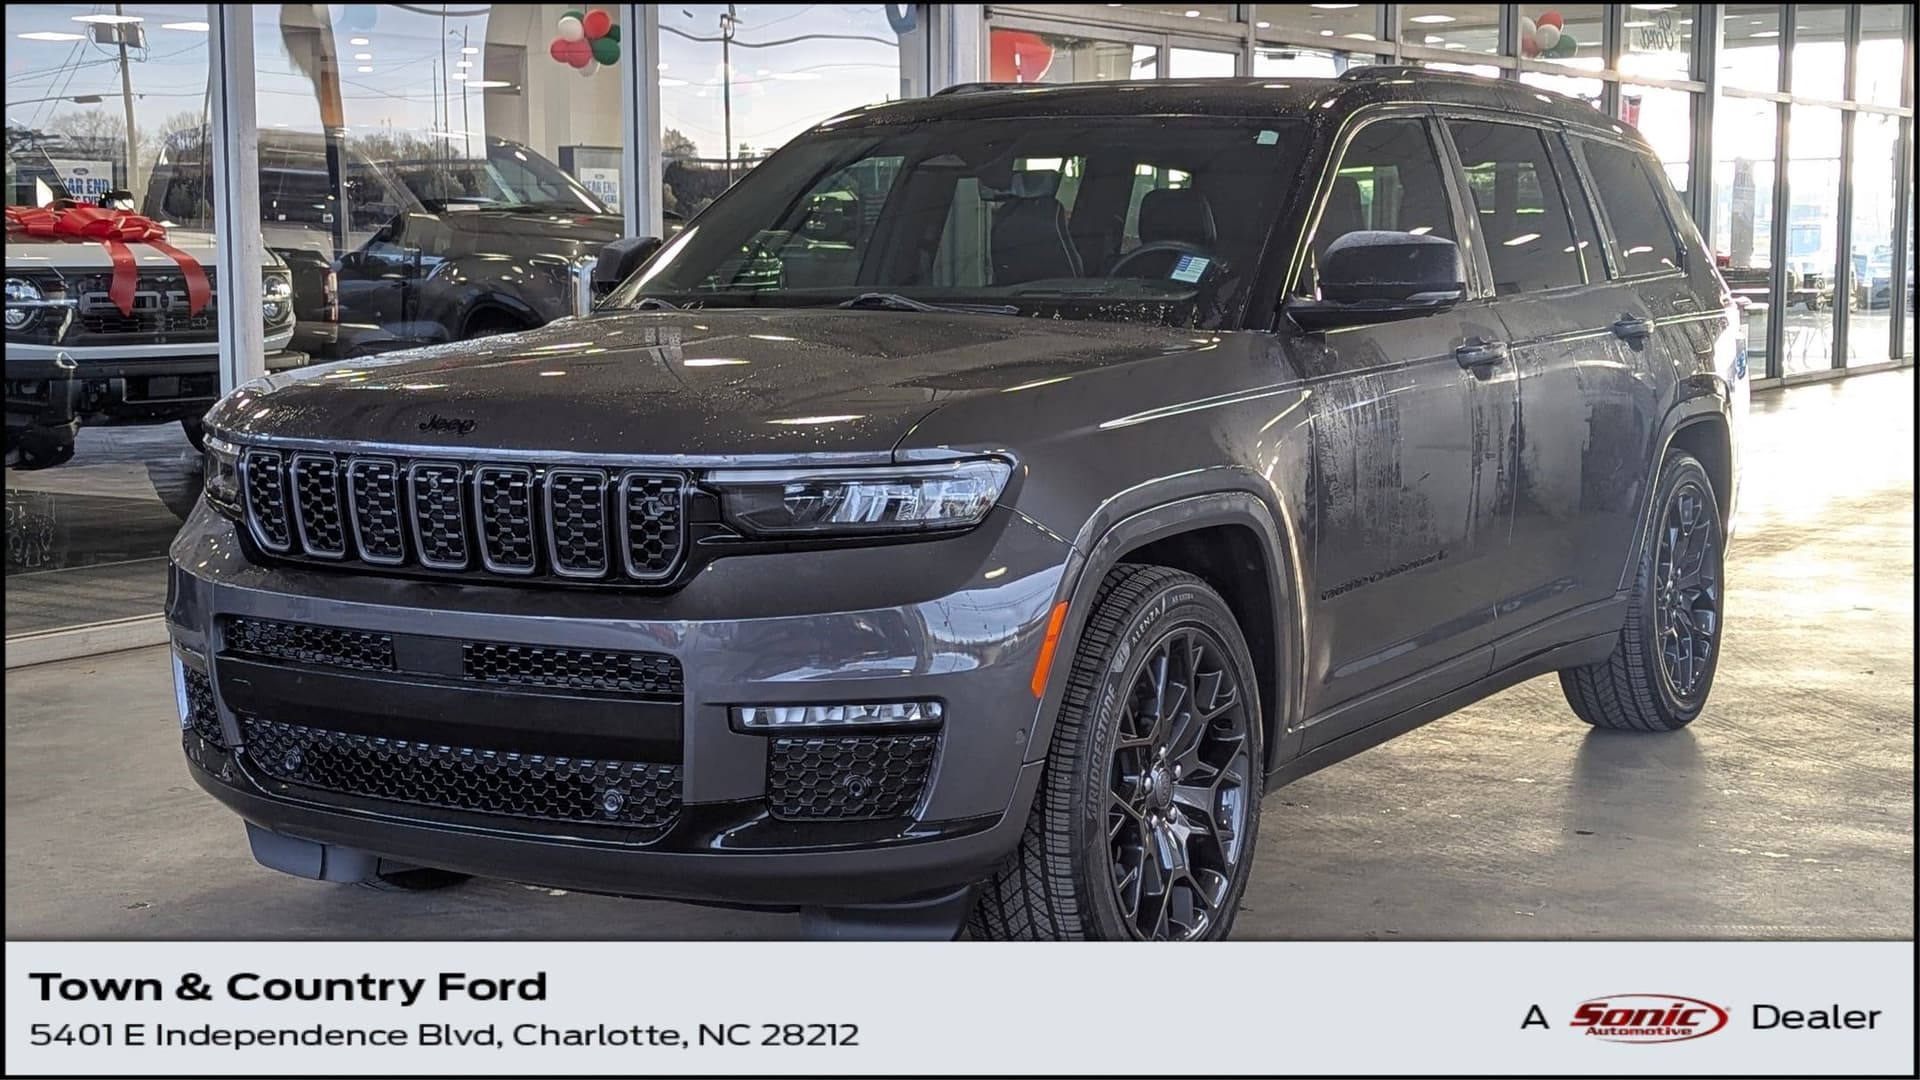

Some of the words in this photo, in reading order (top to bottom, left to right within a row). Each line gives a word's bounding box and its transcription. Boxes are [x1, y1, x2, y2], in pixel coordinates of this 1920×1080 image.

[62, 178, 83, 194] AR
[86, 178, 110, 194] END
[418, 413, 477, 438] Jeep
[1130, 605, 1162, 648] ALENZA
[1086, 682, 1118, 821] BRIDGESTONE
